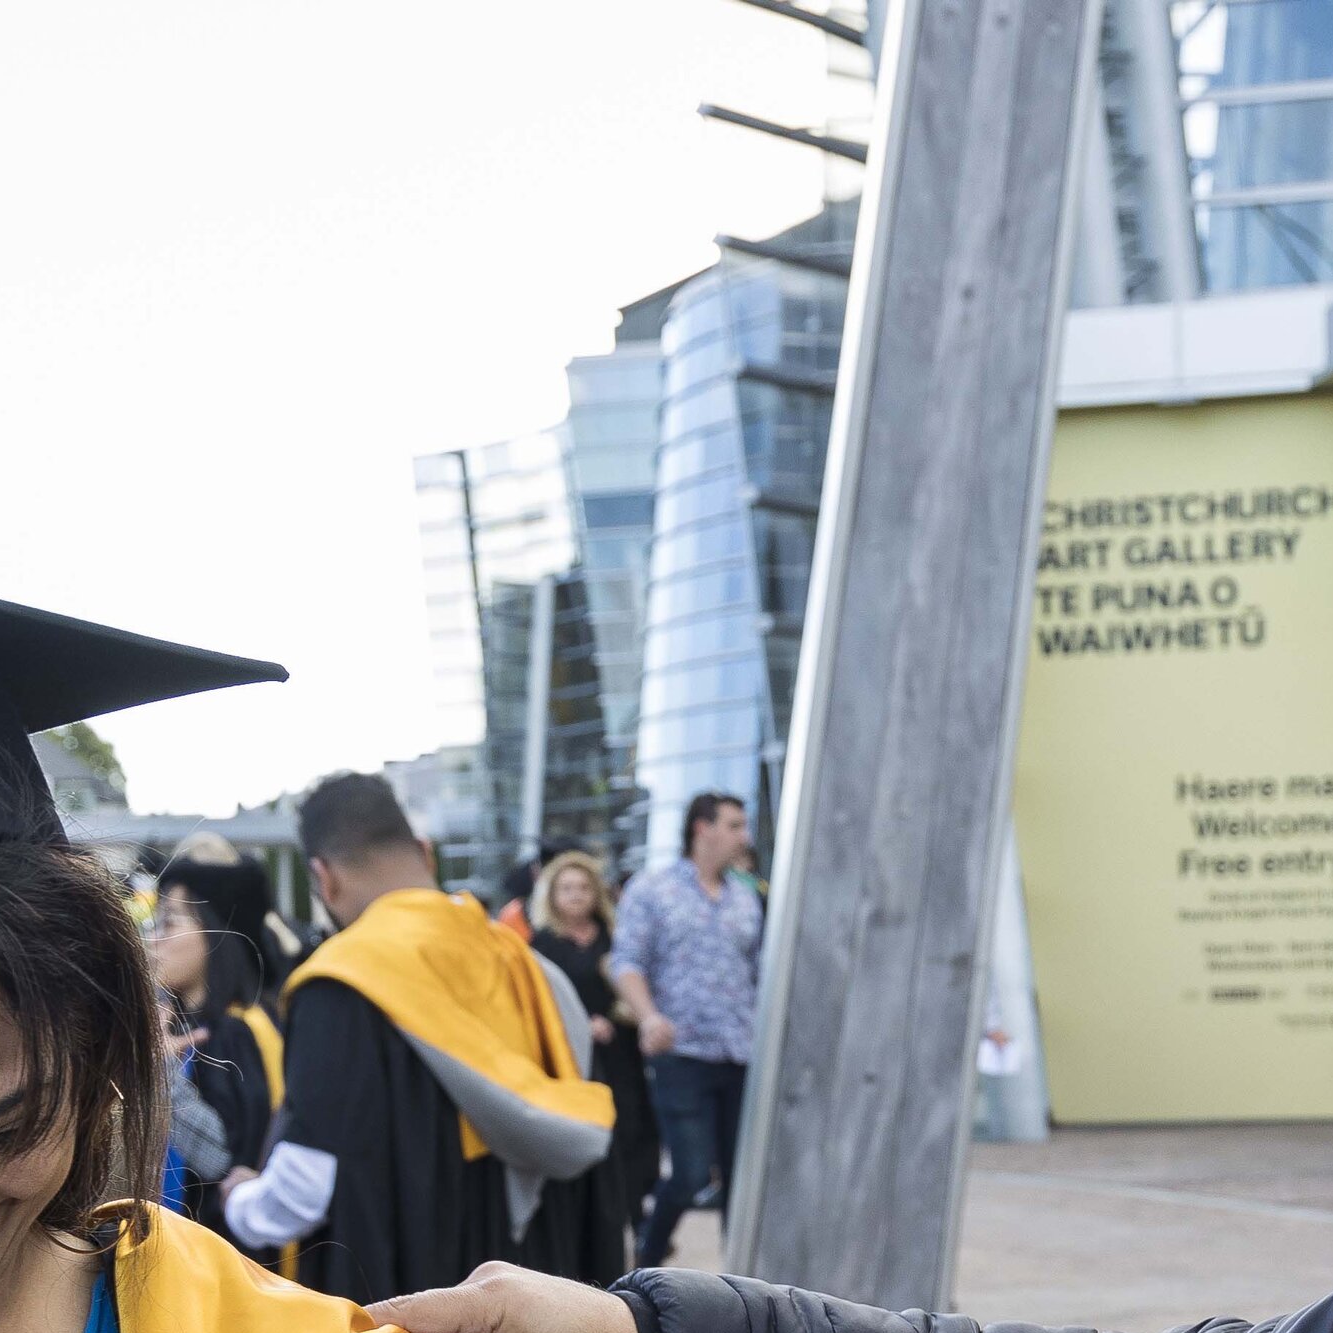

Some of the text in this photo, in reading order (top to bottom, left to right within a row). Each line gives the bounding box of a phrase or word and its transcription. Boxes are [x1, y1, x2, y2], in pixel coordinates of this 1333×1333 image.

[1037, 529, 1300, 570] ART GALLERY
[1037, 576, 1239, 615] TE PUNA O
[1037, 606, 1265, 658] WAIWHETŪ
[1176, 774, 1275, 802] Haere
[1179, 851, 1250, 877] Free
